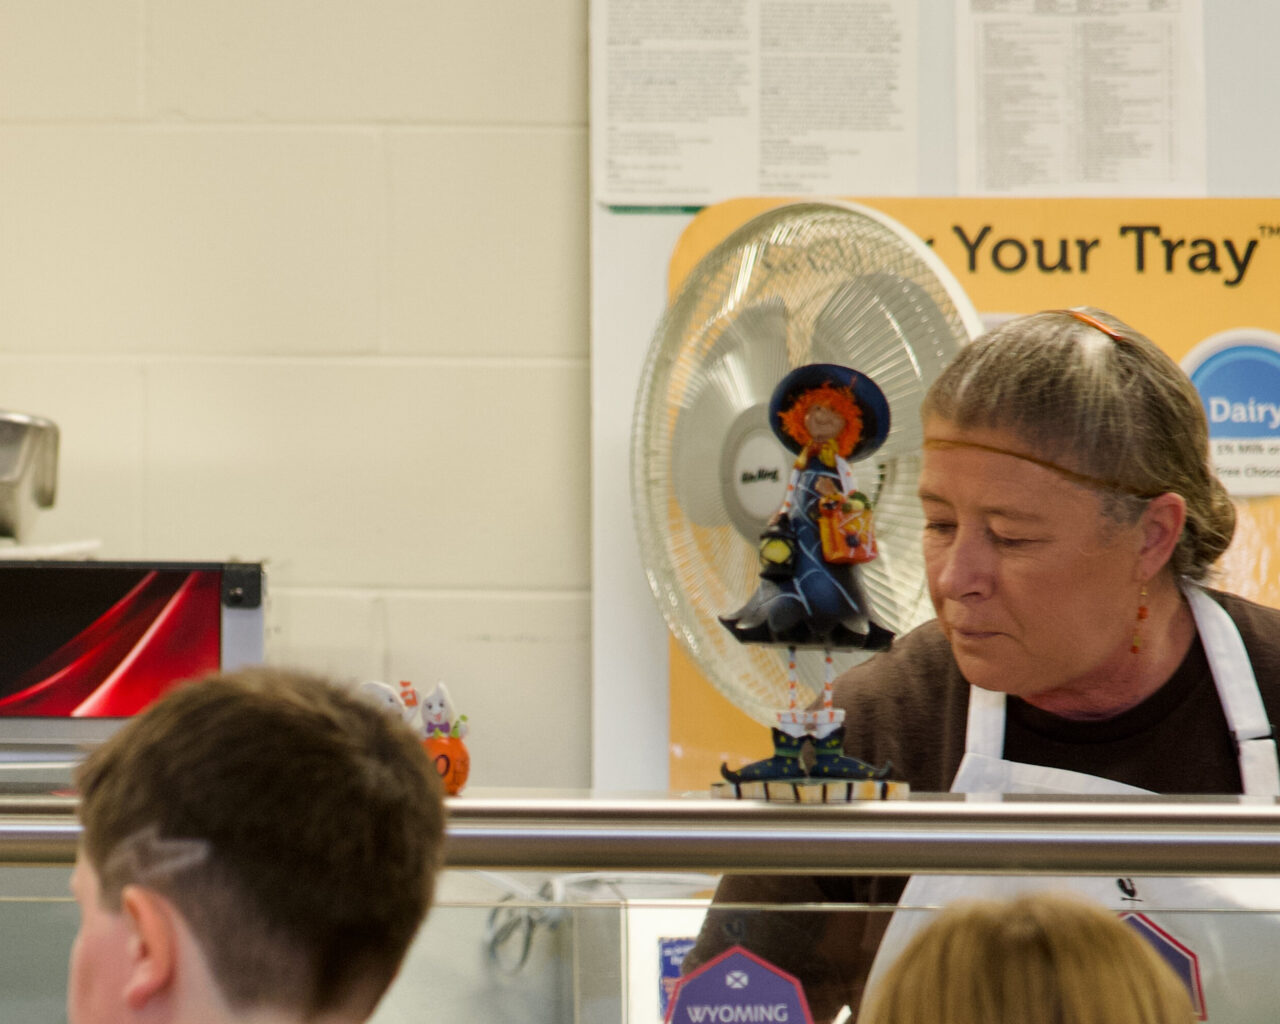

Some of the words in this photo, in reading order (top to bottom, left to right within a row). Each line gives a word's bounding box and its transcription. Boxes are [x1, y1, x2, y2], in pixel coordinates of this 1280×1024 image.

[952, 225, 1100, 273] Your
[1209, 396, 1280, 430] Dairy
[686, 1003, 788, 1023] WYOMING
